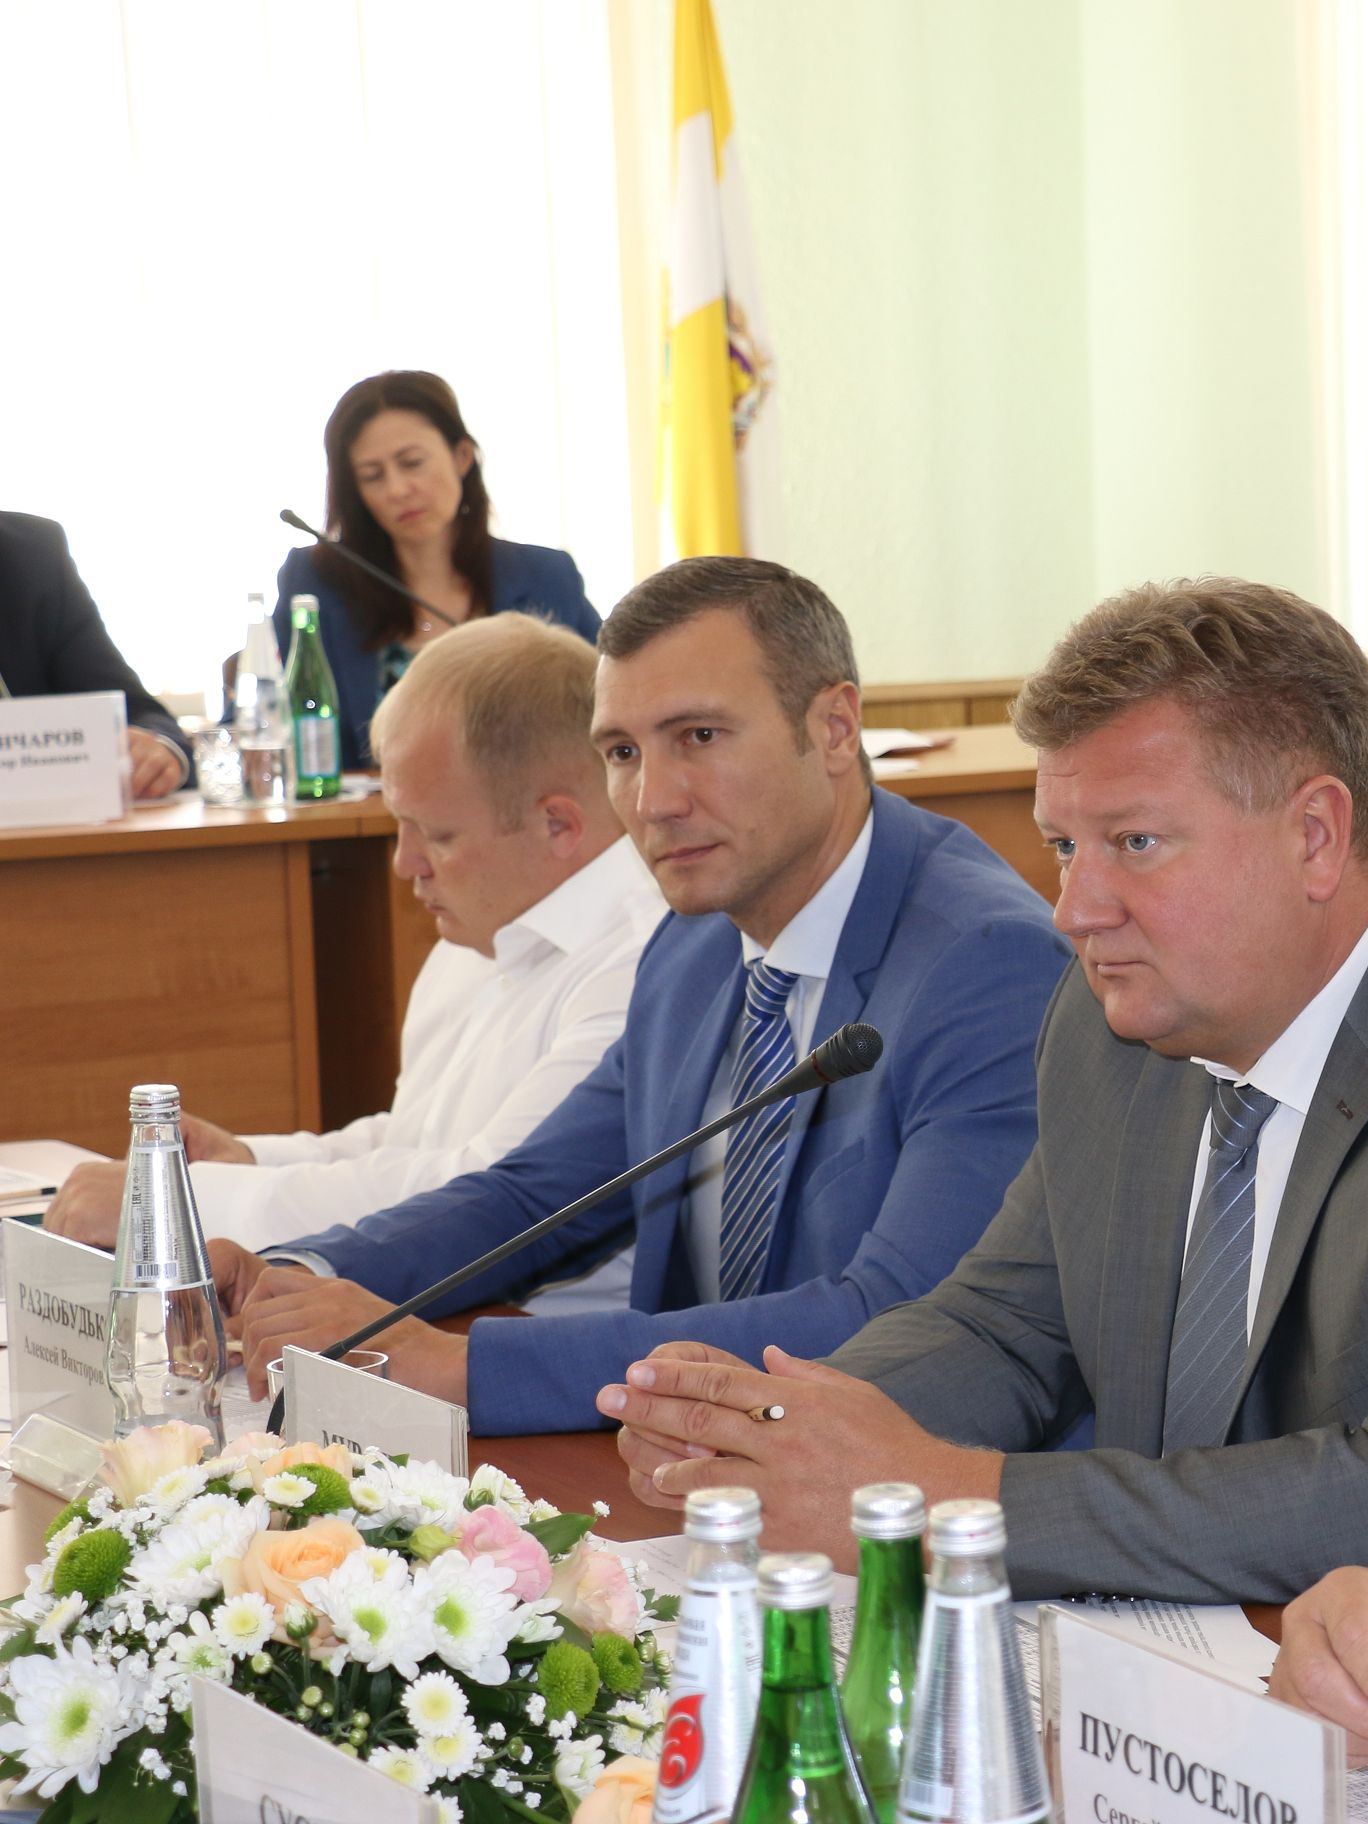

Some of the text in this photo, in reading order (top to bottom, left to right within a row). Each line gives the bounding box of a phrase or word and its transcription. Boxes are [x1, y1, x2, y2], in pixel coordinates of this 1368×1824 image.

[19, 1282, 106, 1342] РАЗДОБУДЬК
[24, 1335, 105, 1386] Алексей Викторов
[1079, 1711, 1298, 1824] ПУСТОСЕЛОВ
